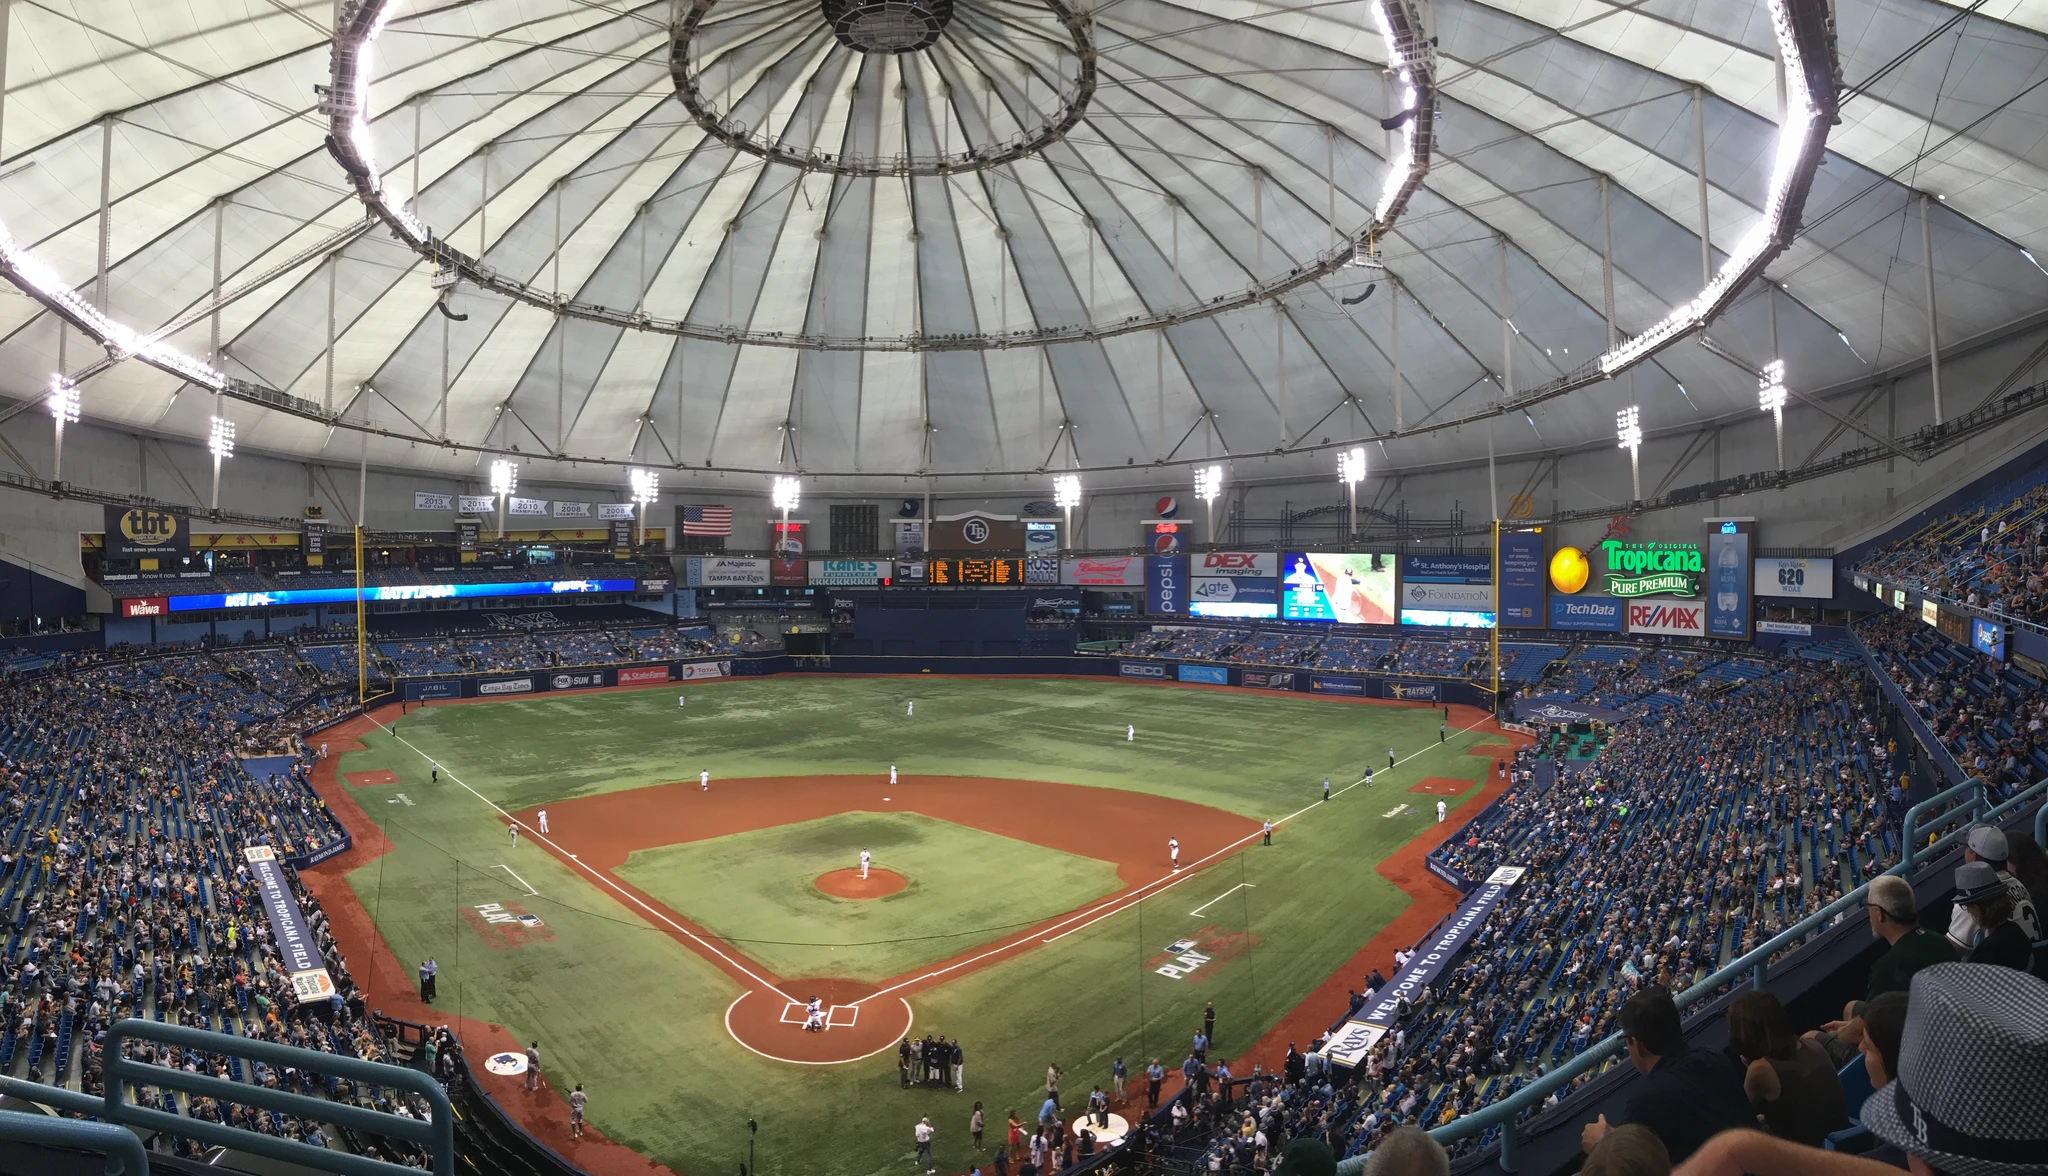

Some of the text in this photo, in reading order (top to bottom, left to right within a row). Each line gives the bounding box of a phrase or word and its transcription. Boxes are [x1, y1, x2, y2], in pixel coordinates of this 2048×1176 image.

[128, 508, 170, 534] tbt
[968, 523, 985, 539] TB
[1026, 559, 1057, 570] ROSE
[1203, 553, 1259, 568] DEX
[1602, 541, 1701, 574] Tropicana
[1215, 568, 1263, 576] imaging
[1430, 563, 1462, 571] Anthony's
[1463, 563, 1490, 571] Hospital
[1026, 571, 1057, 582] RADIOLOGY
[1611, 577, 1687, 593] PURE PREMIUM
[1778, 568, 1804, 585] 620
[1158, 562, 1176, 613] pepsi
[1208, 582, 1229, 594] gte
[130, 605, 160, 615] Wawa
[1630, 605, 1700, 629] RE/MAX
[1122, 665, 1164, 676] GEICO
[574, 676, 589, 685] SUN
[258, 861, 278, 889] WELCOME
[270, 890, 282, 899] TO
[274, 899, 299, 943] TROPICANA
[474, 903, 518, 923] PLAY
[290, 943, 312, 969] FIELD
[1367, 884, 1501, 1021] WELCOME TO TROPICANA FIELD
[1155, 950, 1211, 979] PLAY
[1326, 1027, 1372, 1058] RAYS
[1910, 1101, 1928, 1144] TB
